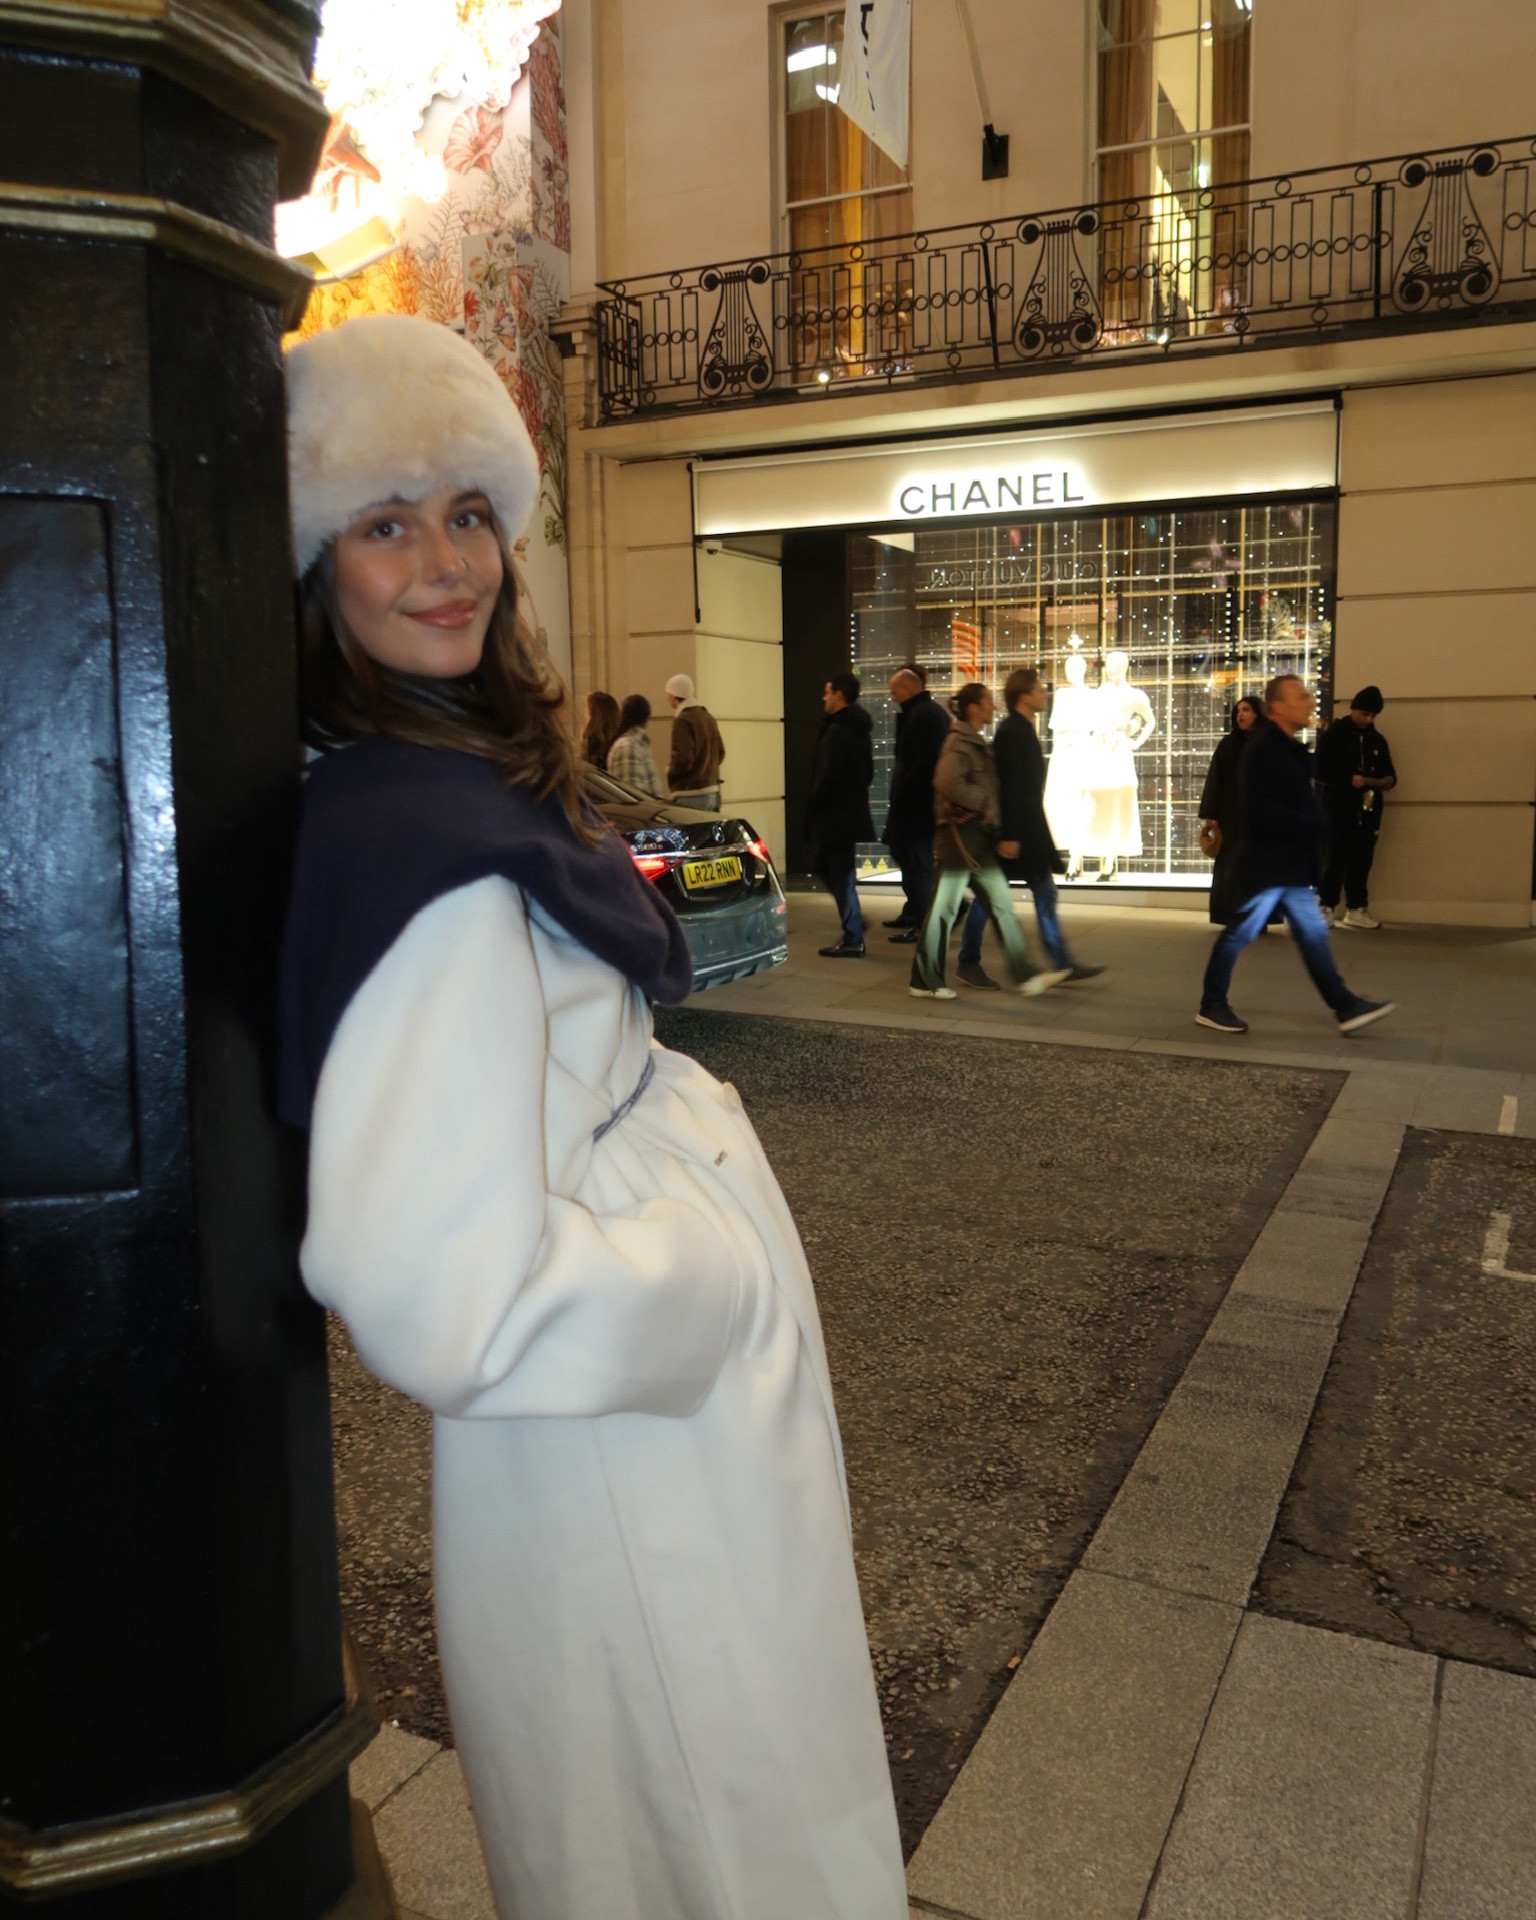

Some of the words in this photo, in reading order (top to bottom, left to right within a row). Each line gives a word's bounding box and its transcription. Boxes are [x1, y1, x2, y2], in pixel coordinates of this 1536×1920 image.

[900, 472, 1084, 515] CHANEL
[687, 863, 716, 885] LR22
[715, 860, 737, 880] RNN
